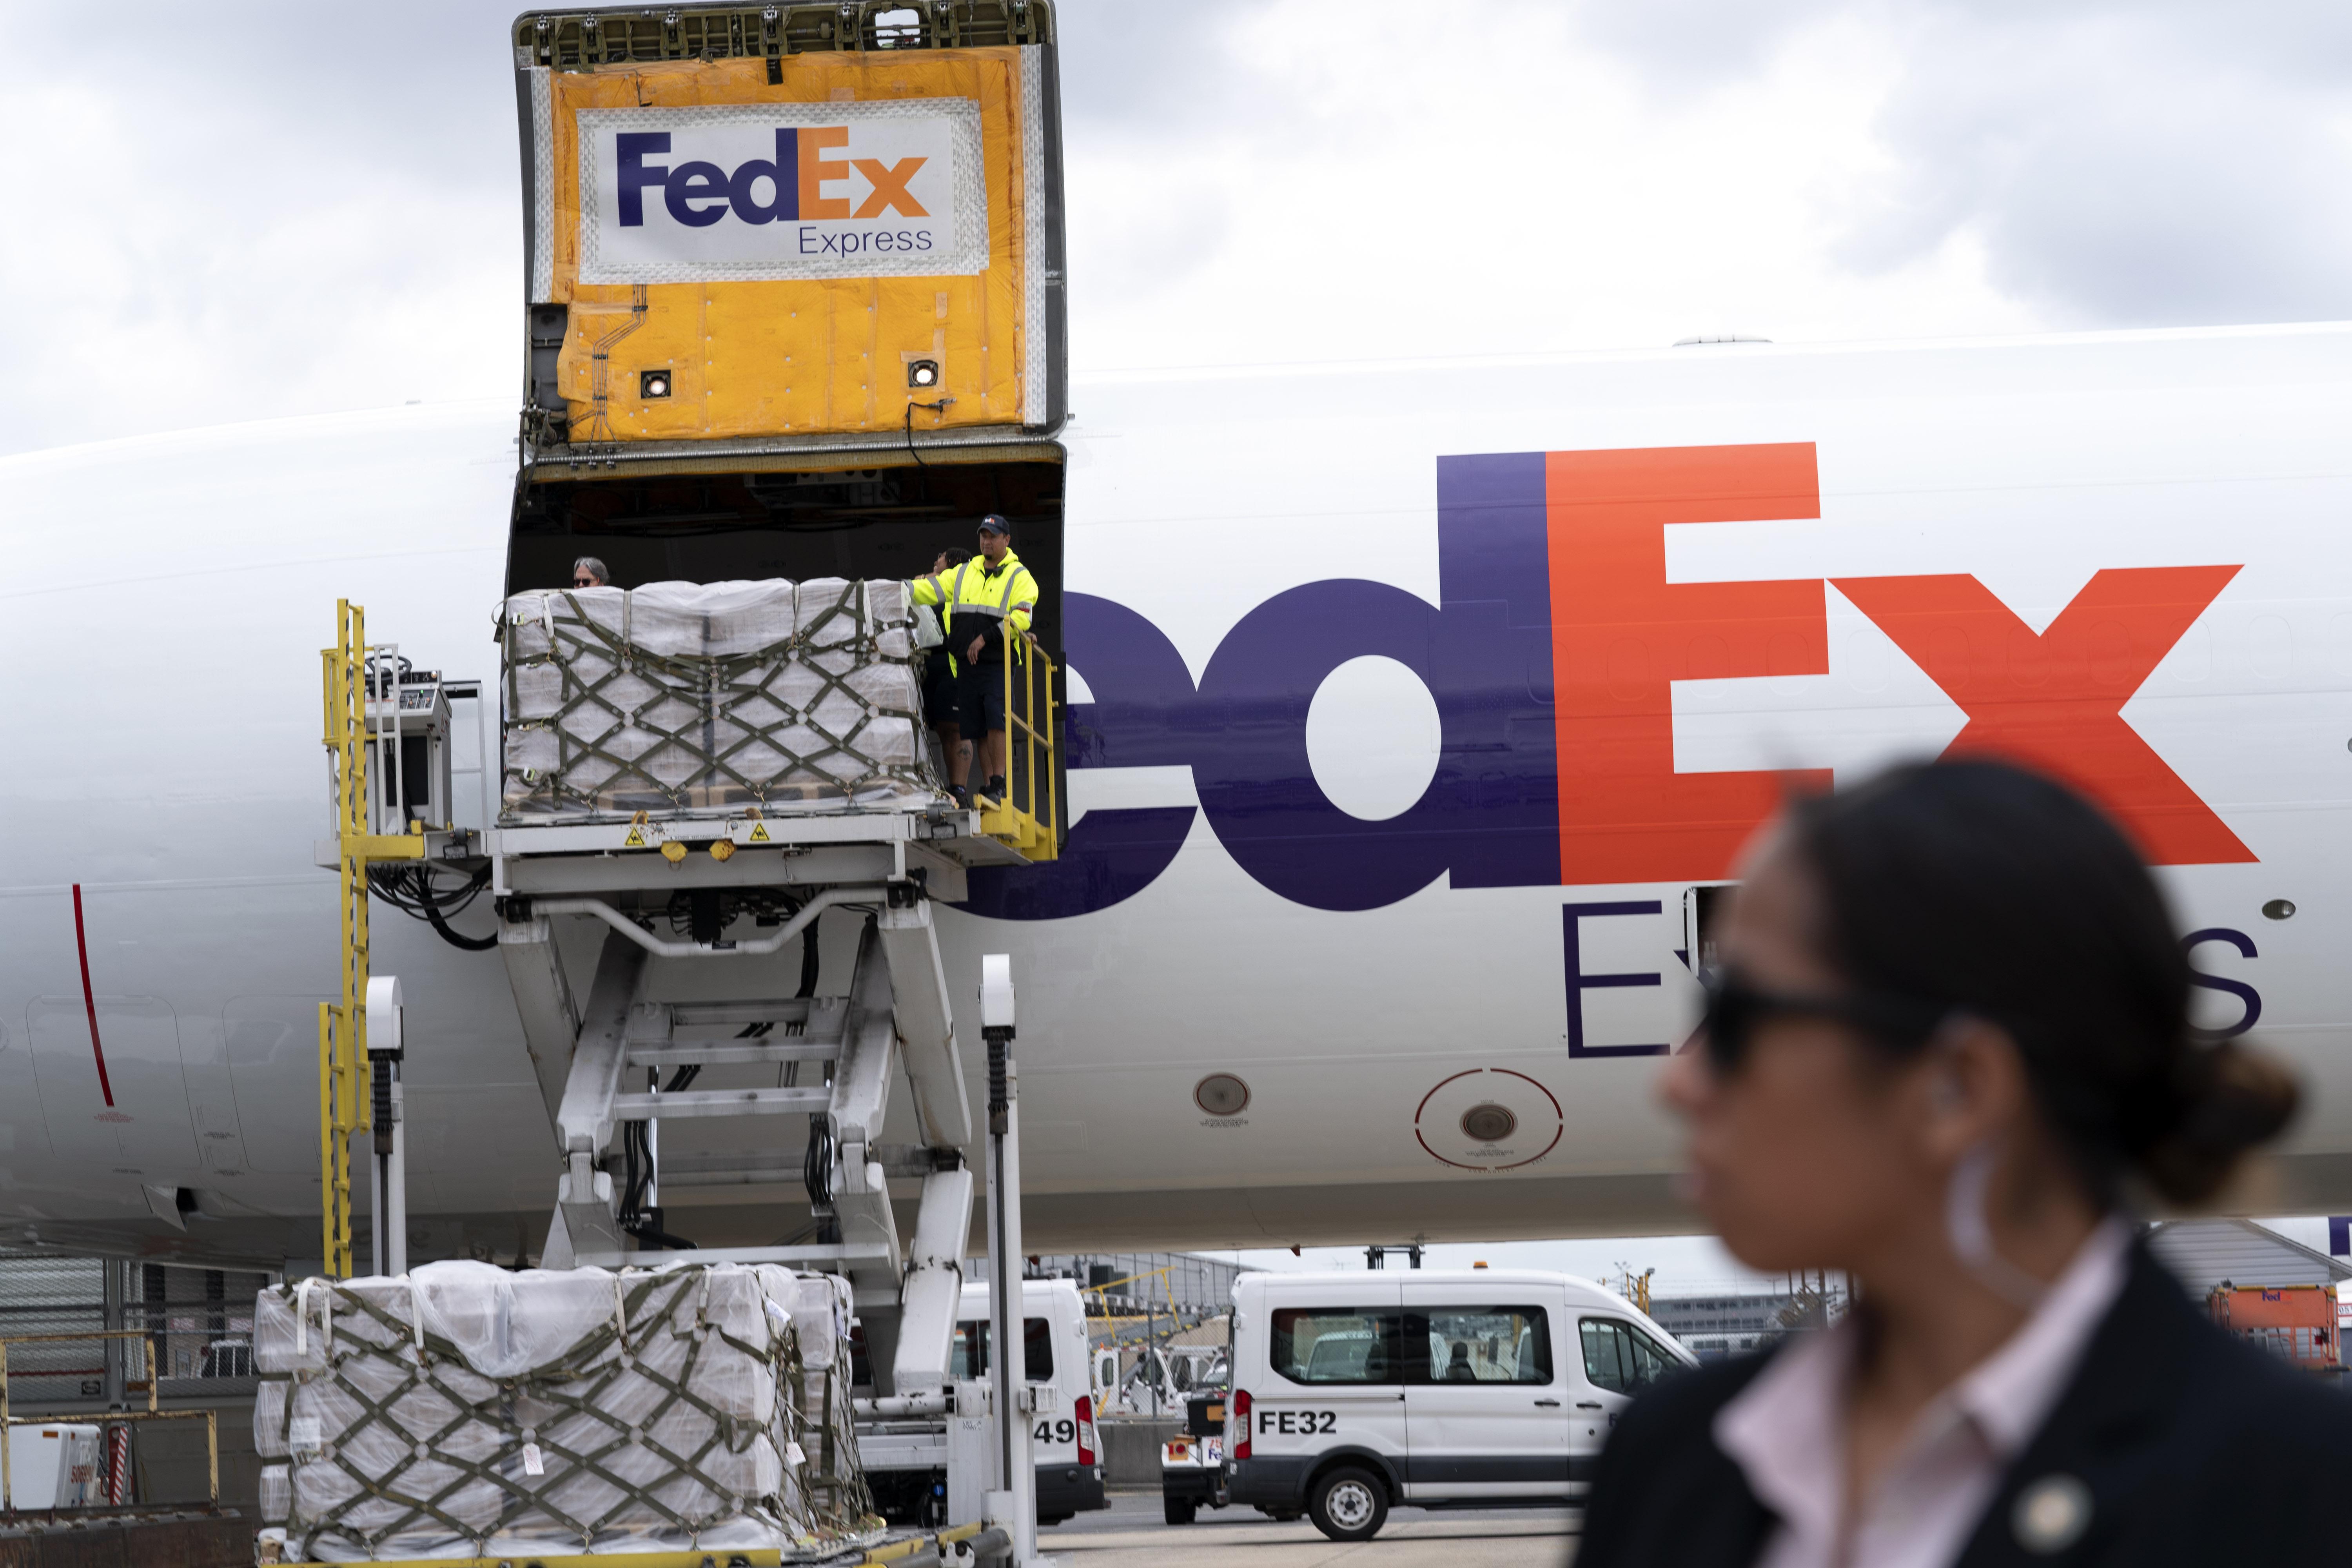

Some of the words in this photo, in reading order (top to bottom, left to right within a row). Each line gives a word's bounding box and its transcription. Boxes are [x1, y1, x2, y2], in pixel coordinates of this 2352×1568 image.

[616, 126, 931, 227] FedEx
[799, 226, 933, 258] Express
[939, 442, 2258, 920] edEx
[1259, 1410, 1337, 1435] FE32
